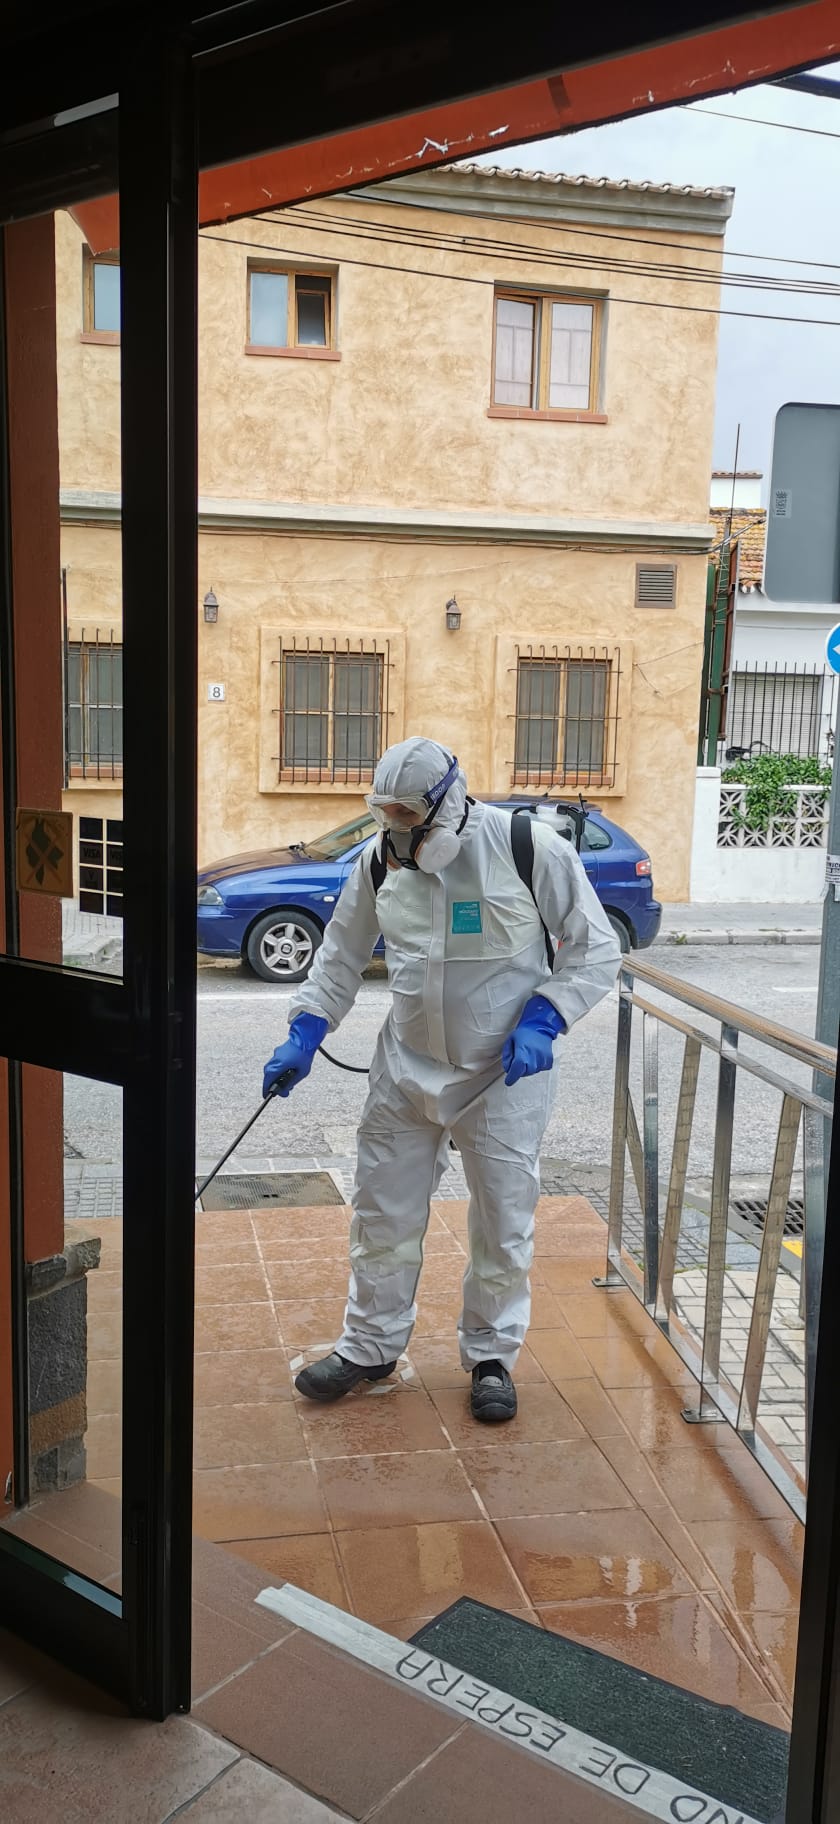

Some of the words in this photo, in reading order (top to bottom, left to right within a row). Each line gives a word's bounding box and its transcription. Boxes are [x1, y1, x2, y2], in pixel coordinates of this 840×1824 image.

[213, 687, 220, 698] 8
[396, 1650, 567, 1752] ESPERA
[579, 1746, 650, 1795] DE
